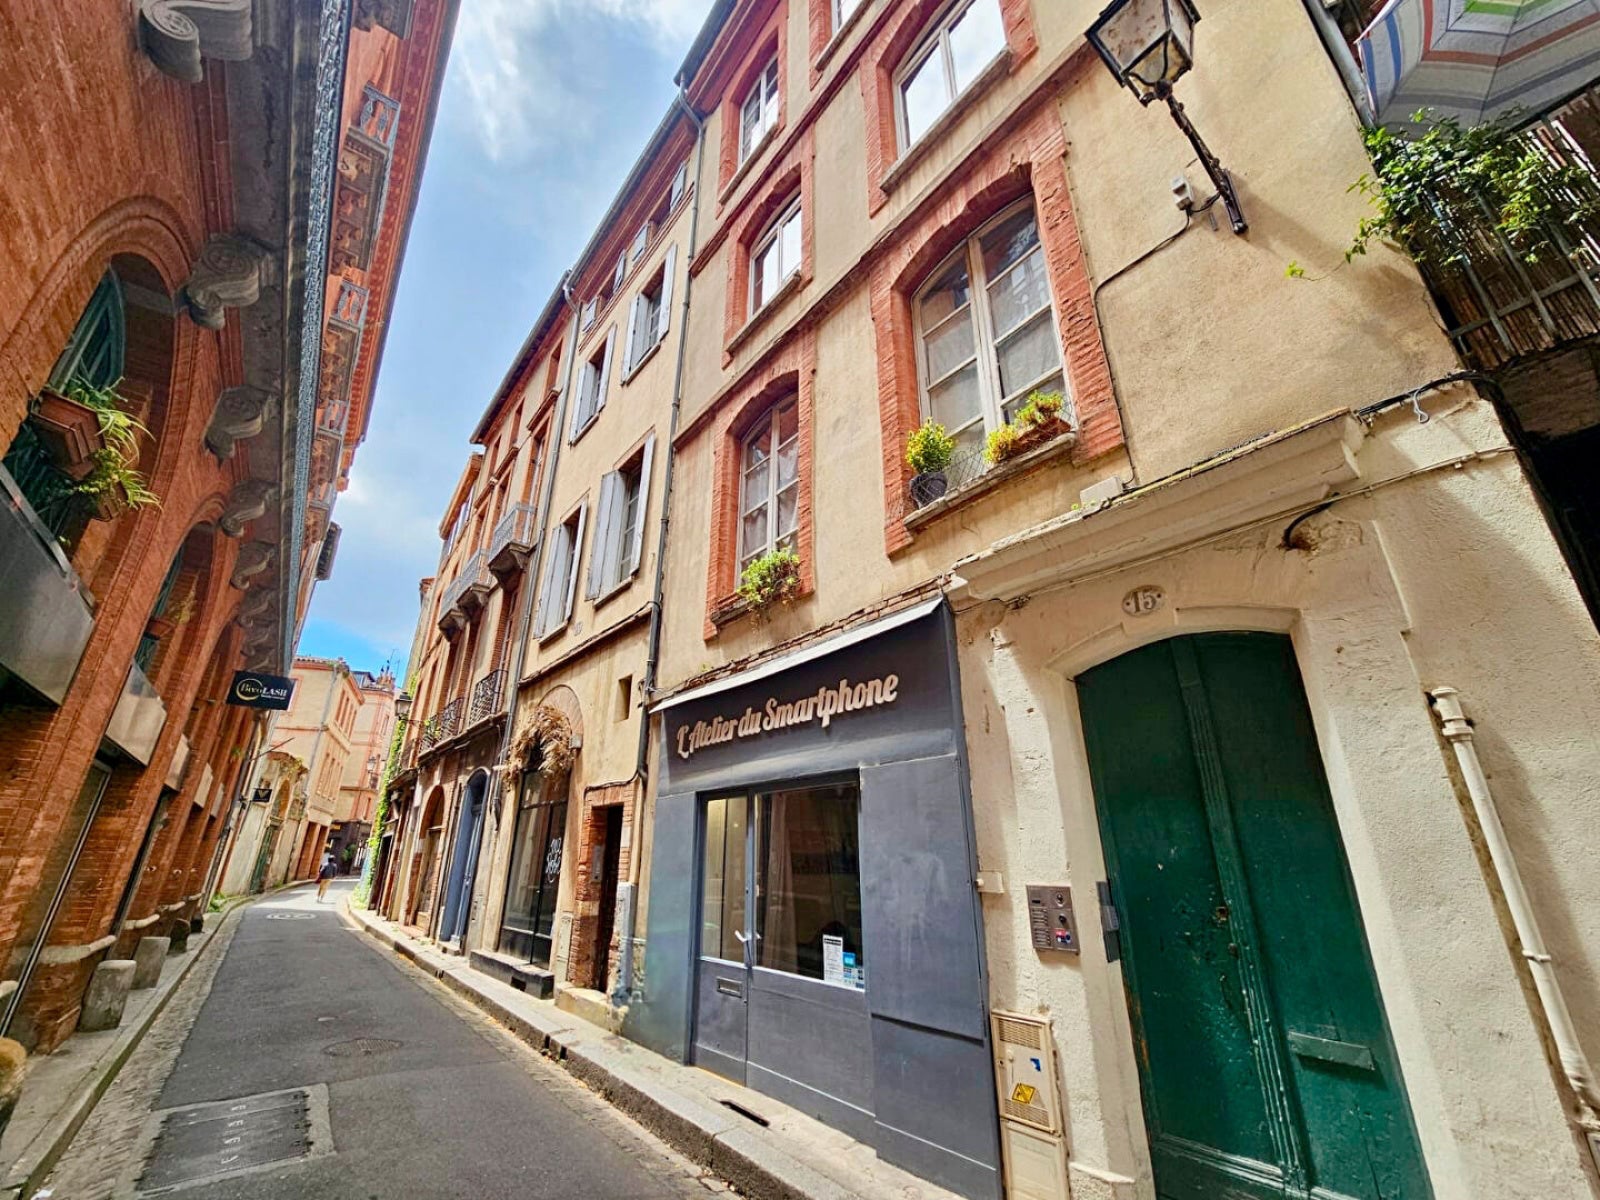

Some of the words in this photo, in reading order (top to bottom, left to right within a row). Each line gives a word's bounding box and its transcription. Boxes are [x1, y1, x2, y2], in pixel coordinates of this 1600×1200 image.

[1130, 590, 1157, 612] 15
[677, 715, 738, 759] L'Atelier
[738, 707, 762, 738] du
[762, 674, 899, 729] Smartphone
